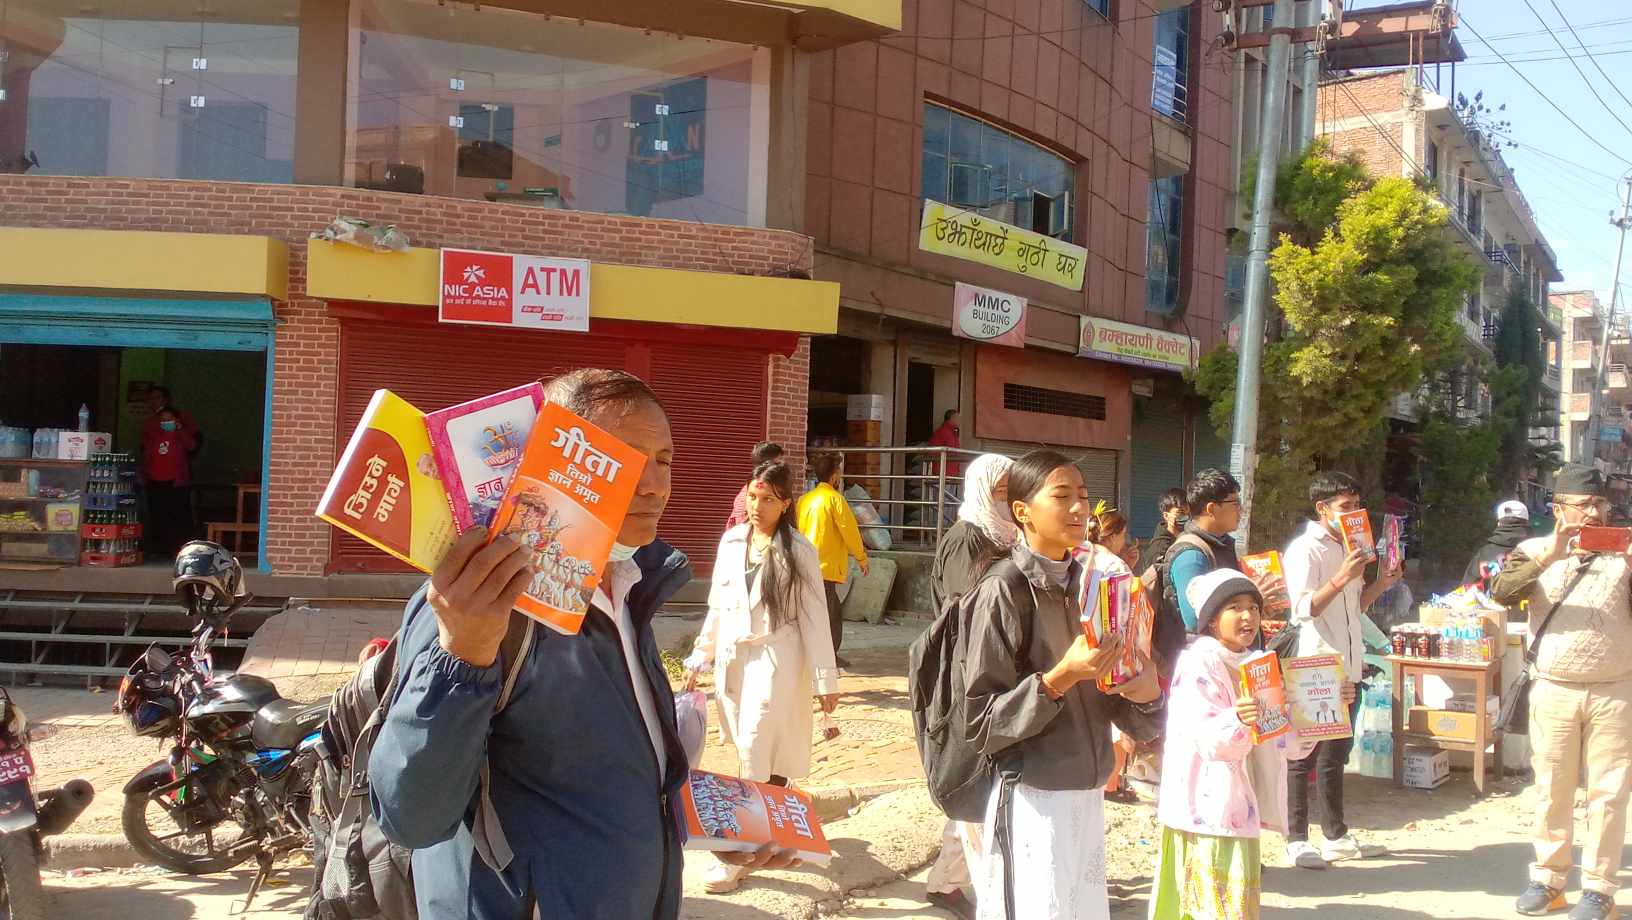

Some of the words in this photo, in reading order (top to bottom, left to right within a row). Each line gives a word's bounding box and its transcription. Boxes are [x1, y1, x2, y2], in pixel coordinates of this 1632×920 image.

[1017, 239, 1050, 273] गुठी
[1056, 253, 1079, 279] घर
[444, 284, 469, 297] NIC
[472, 286, 508, 299] ASIA
[520, 266, 580, 297] ATM
[972, 309, 1010, 326] BUILDING
[974, 292, 1011, 313] MMC
[982, 323, 1000, 336] 2067
[550, 426, 623, 483] गीता
[344, 454, 388, 520] जिउने
[474, 476, 503, 503] ज्ञान
[547, 468, 573, 489] ज्ञान
[575, 483, 601, 504] अमृत
[566, 463, 593, 486] तिम्रो
[373, 474, 405, 523] मार्ग
[784, 794, 814, 839] गीता
